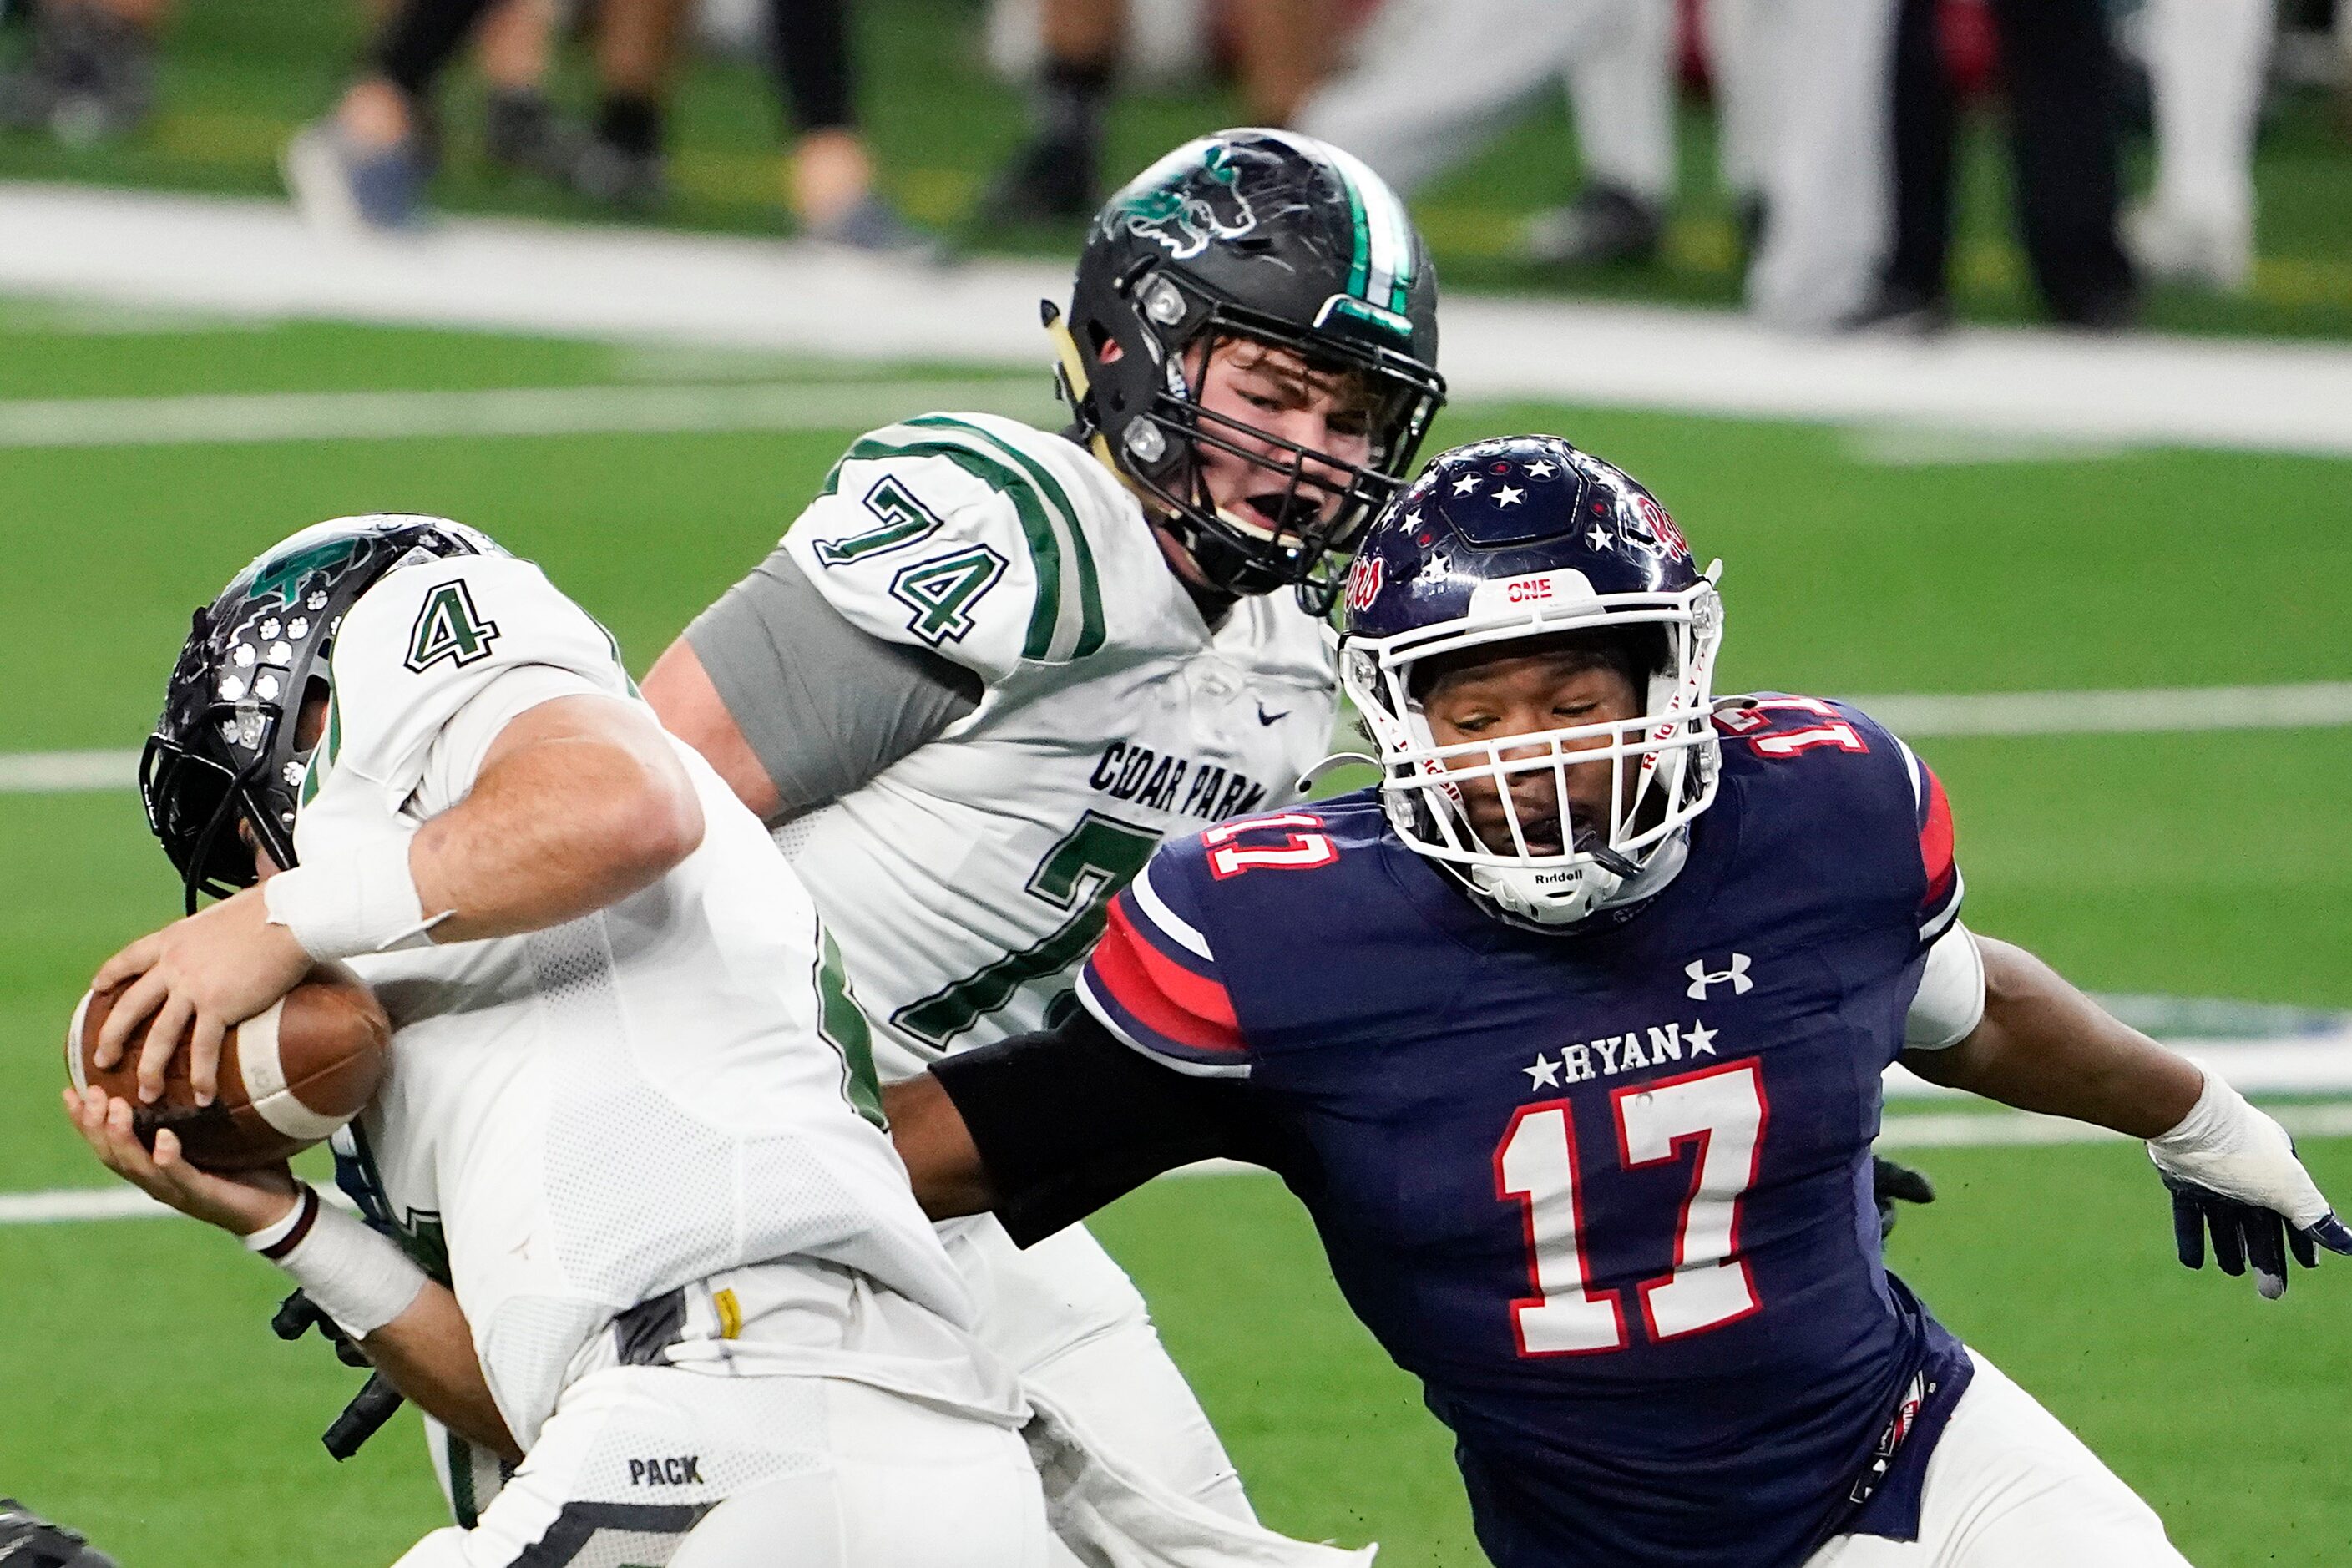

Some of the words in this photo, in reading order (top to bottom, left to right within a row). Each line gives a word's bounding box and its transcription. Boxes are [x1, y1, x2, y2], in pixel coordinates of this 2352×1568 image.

[812, 473, 1010, 648] 74
[1508, 578, 1552, 603] ONE
[403, 578, 501, 675] 4
[1089, 741, 1189, 812] CEDAR
[1179, 764, 1267, 822] PARK
[1200, 812, 1340, 881] 17
[1535, 869, 1583, 884] Riddell
[889, 809, 1164, 1052] 7
[1560, 1022, 1683, 1084] RYAN
[1492, 1055, 1771, 1358] 17
[629, 1455, 704, 1486] PACK
